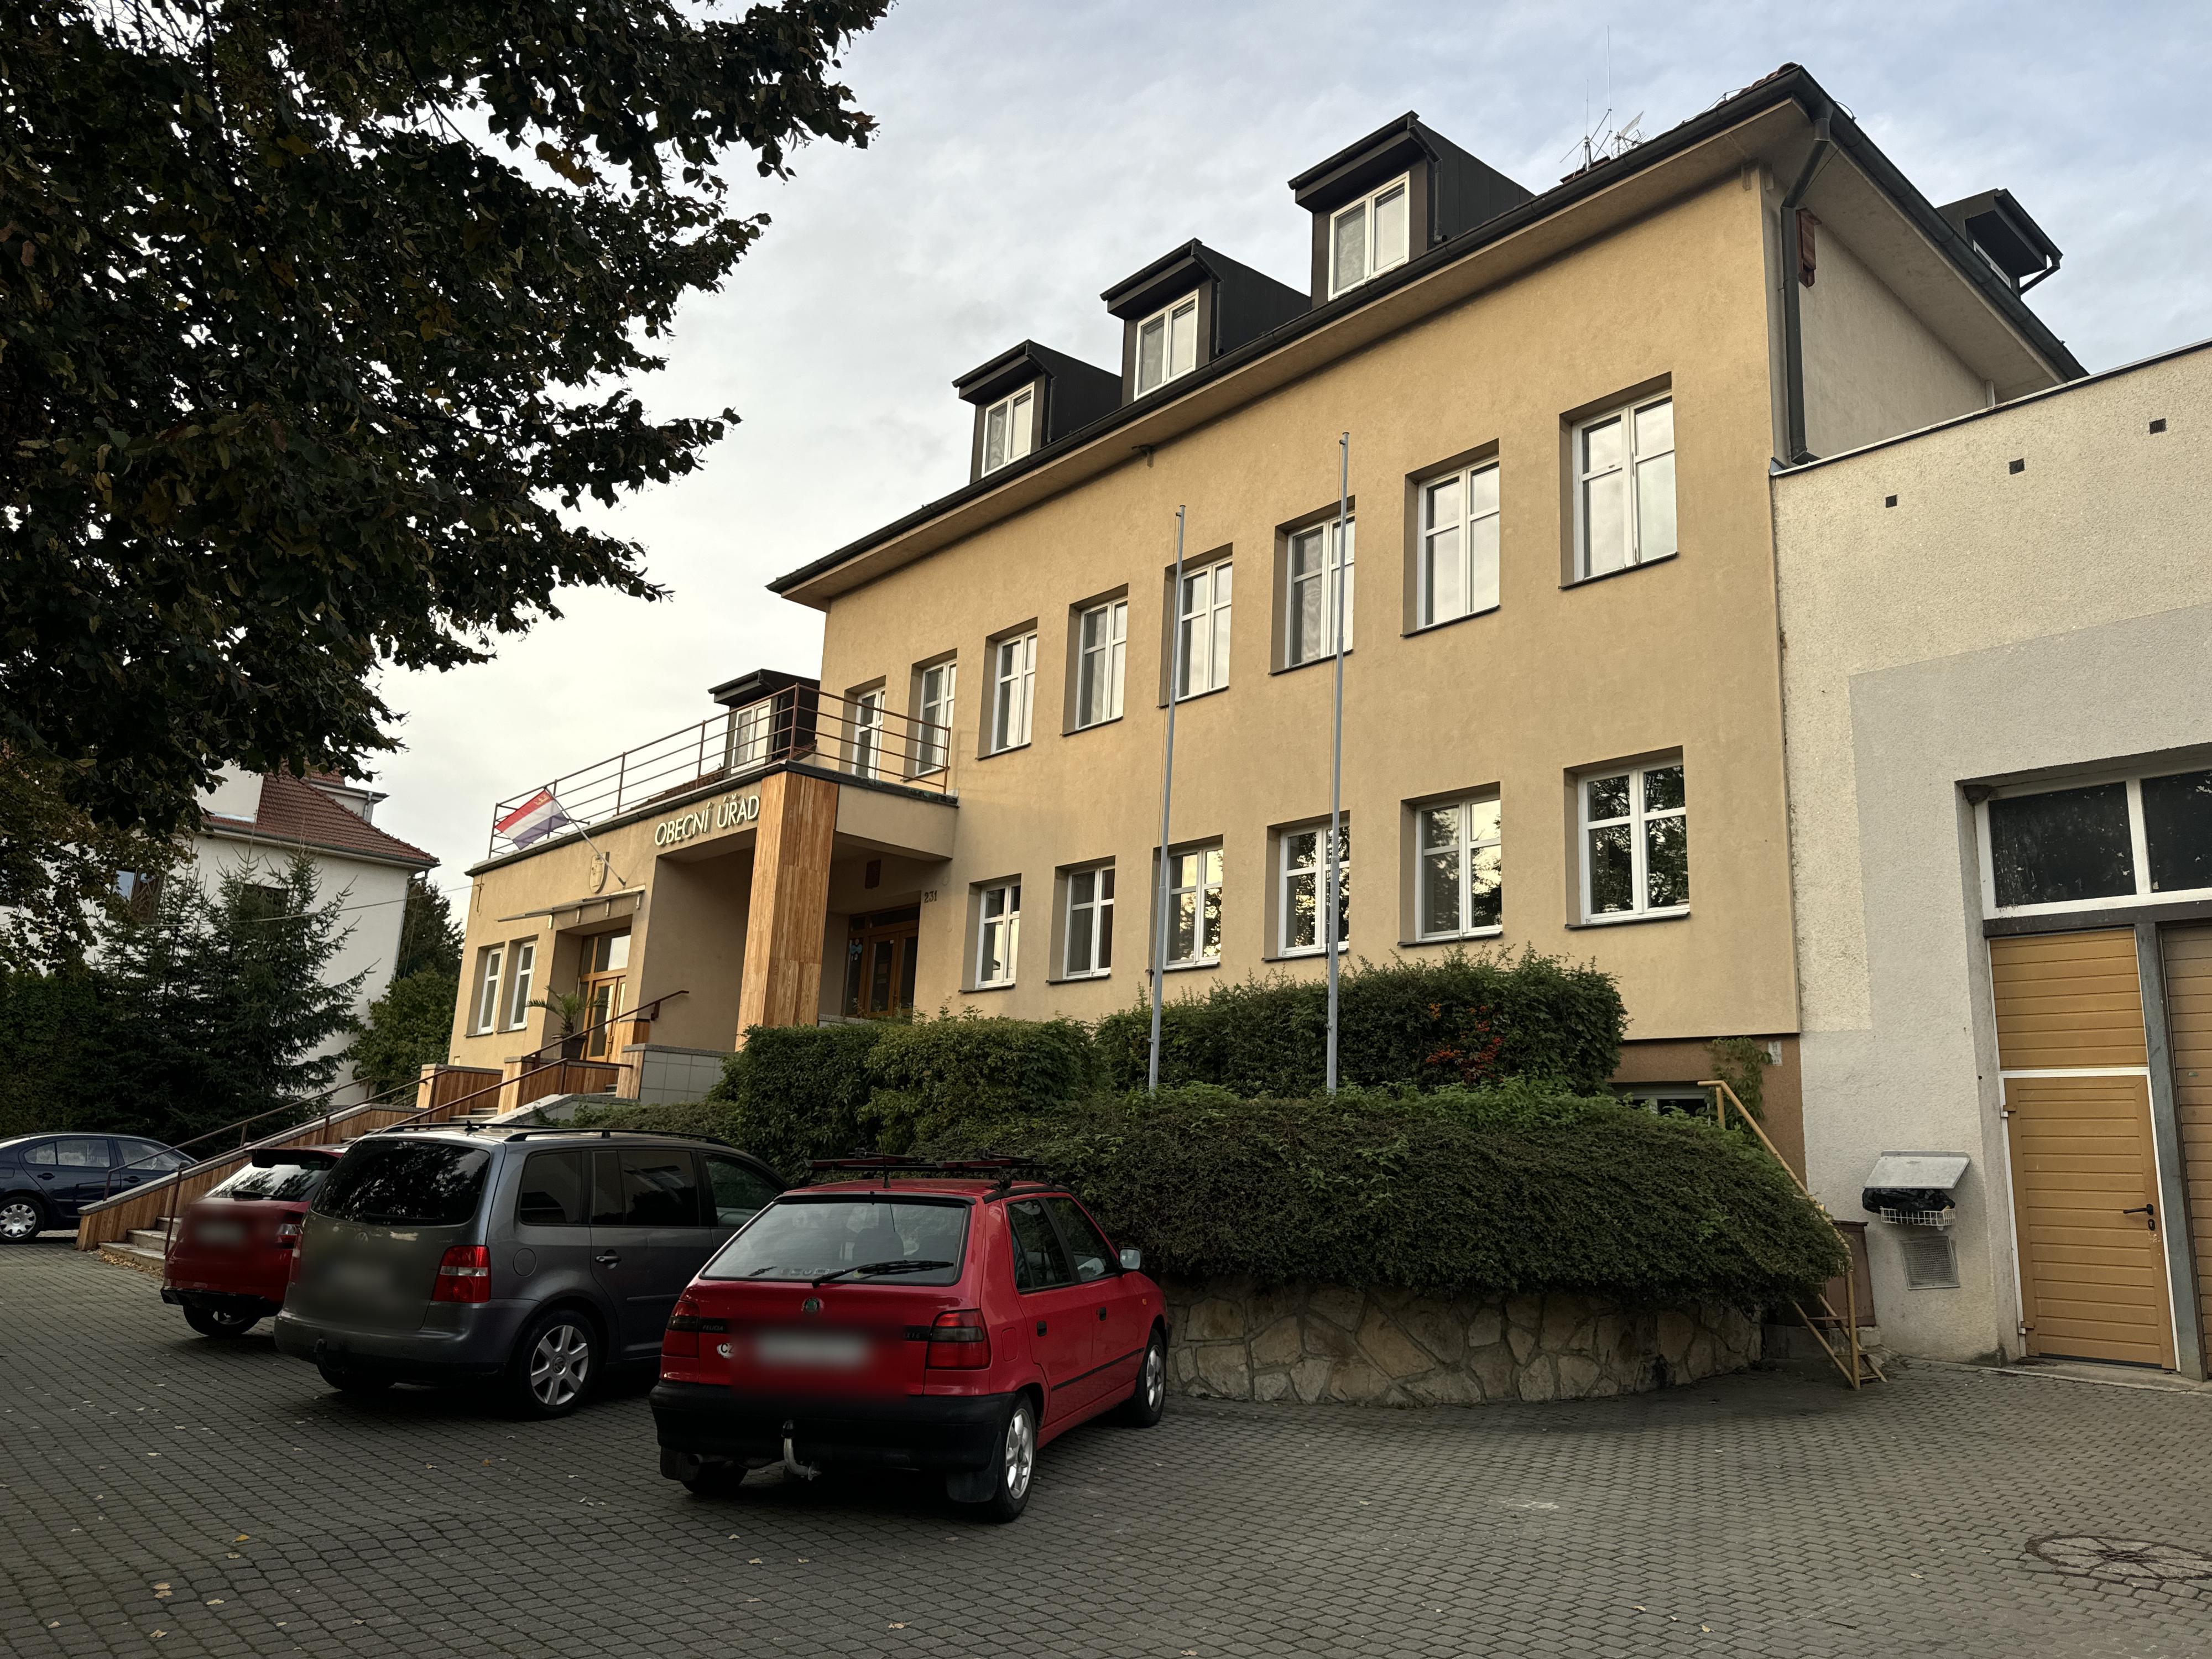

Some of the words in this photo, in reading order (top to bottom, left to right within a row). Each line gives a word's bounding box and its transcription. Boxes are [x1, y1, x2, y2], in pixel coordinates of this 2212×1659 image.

[655, 802, 711, 846] OBECNÍ
[717, 793, 760, 828] ÚŘAD
[924, 890, 937, 903] 231
[721, 1343, 735, 1354] CZ
